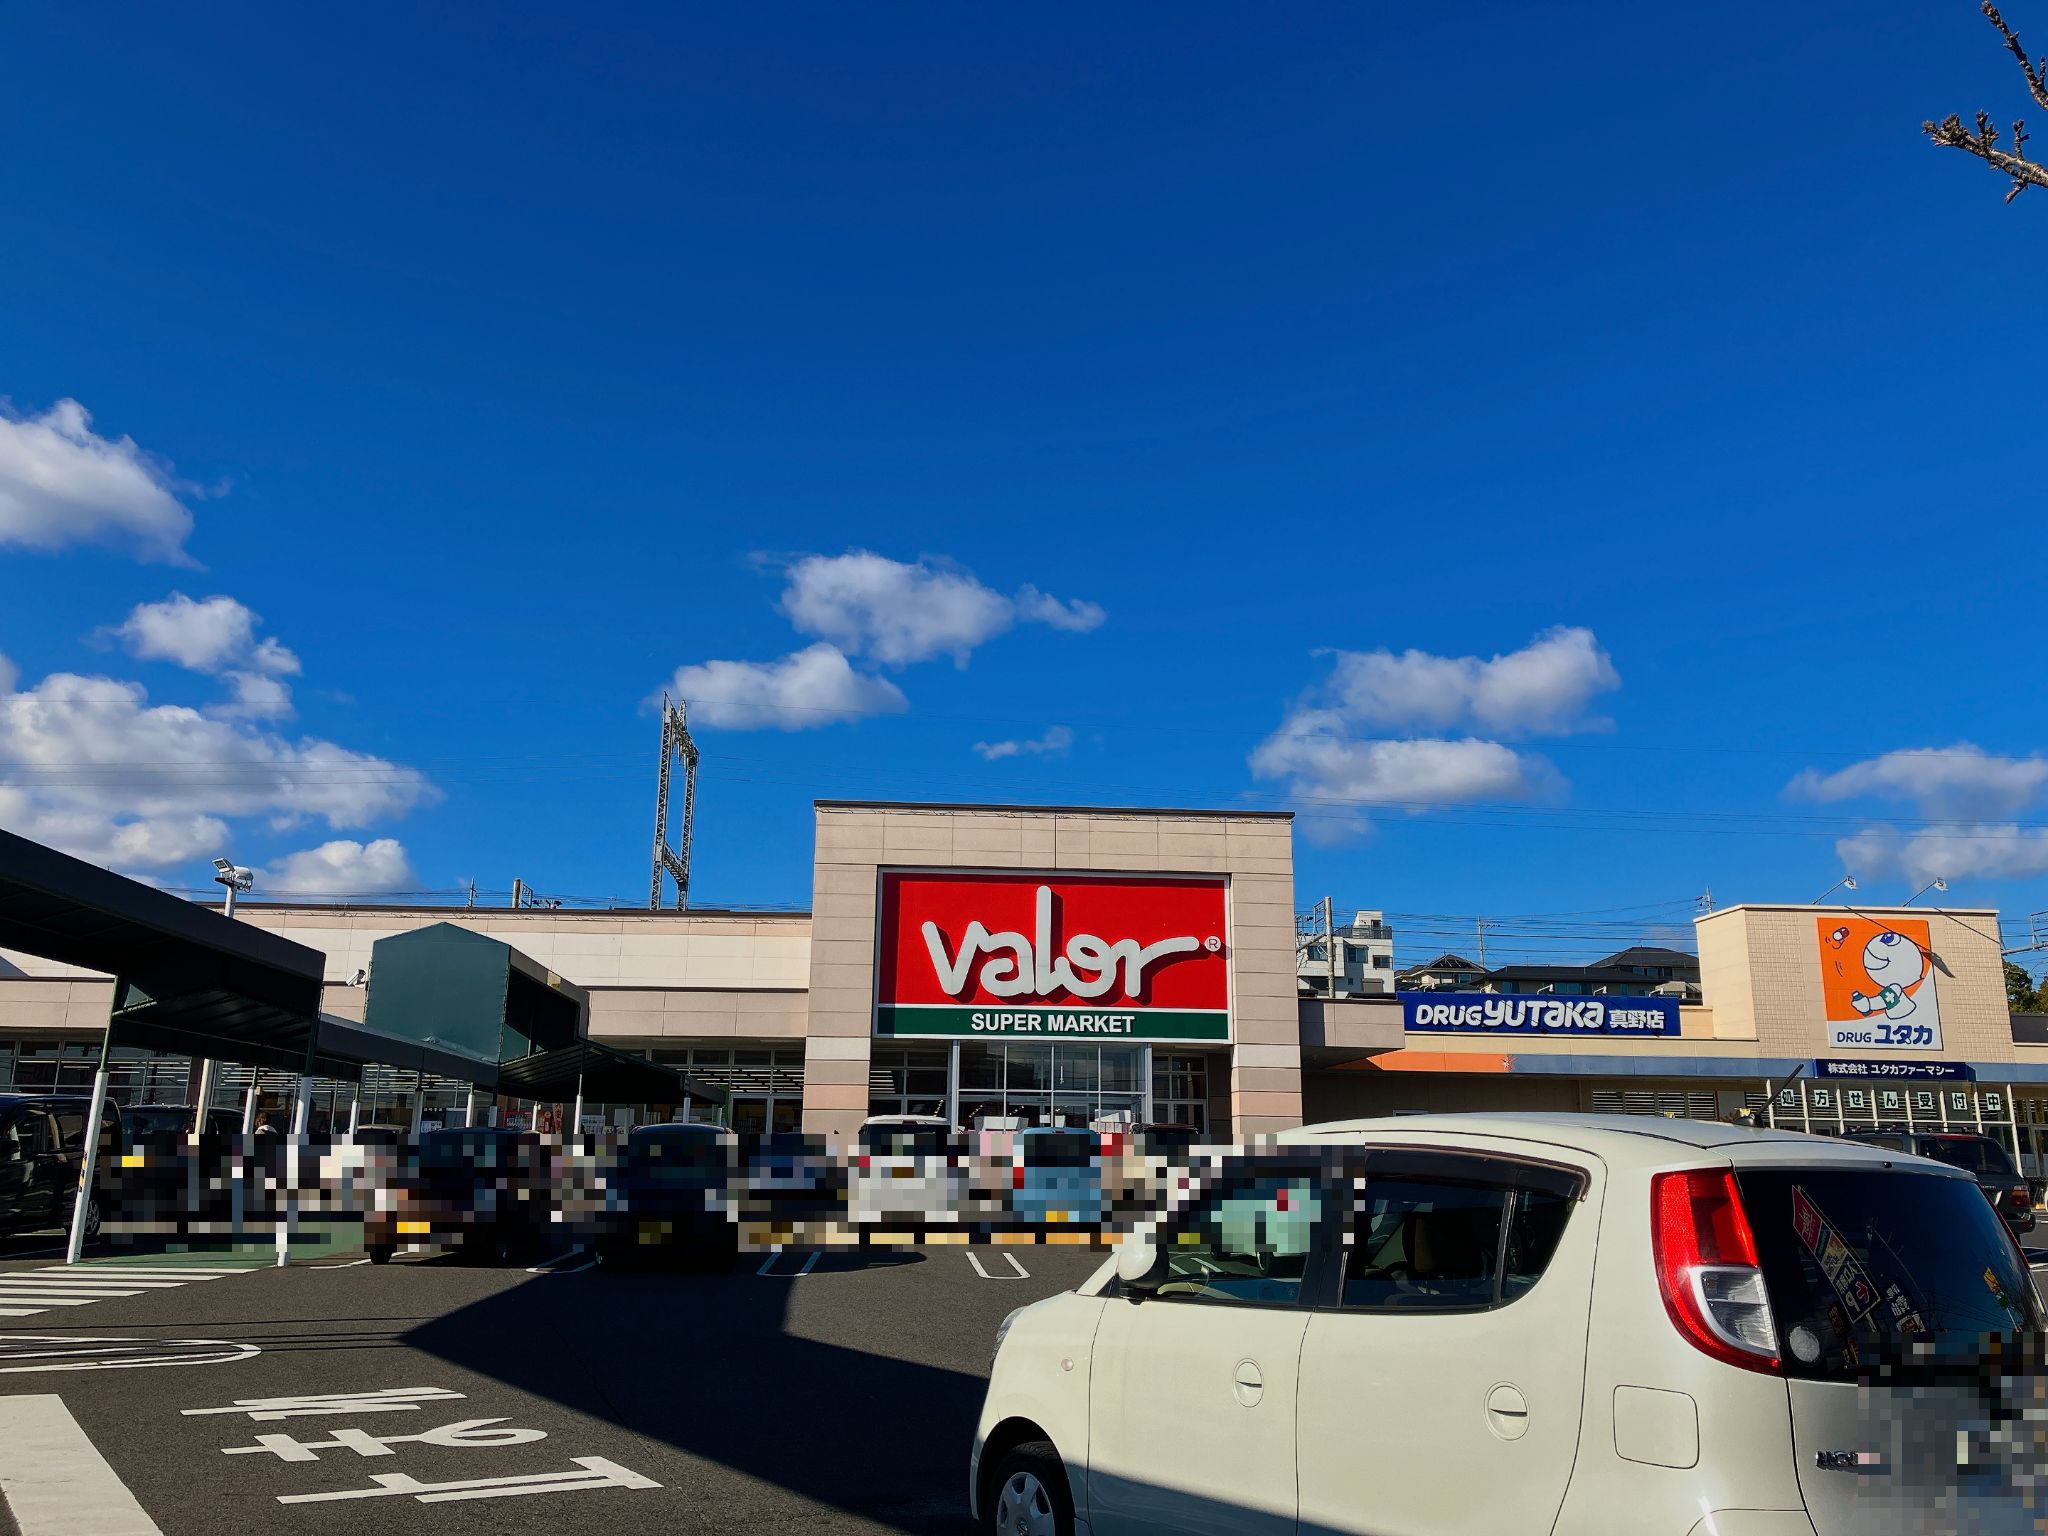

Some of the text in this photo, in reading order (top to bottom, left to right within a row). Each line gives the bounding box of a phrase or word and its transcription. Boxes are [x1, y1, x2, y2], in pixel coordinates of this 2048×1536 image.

[921, 885, 1199, 998] valor
[971, 1013, 1135, 1034] SUPER MARKET
[1415, 1004, 1482, 1026] DRUG
[1608, 1009, 1665, 1030] 真野店
[1837, 1024, 1933, 1046] DRUG ユタカ
[1828, 1062, 1955, 1076] 株式会社 ユタカファーマシー
[180, 1386, 665, 1504] 止まれ
